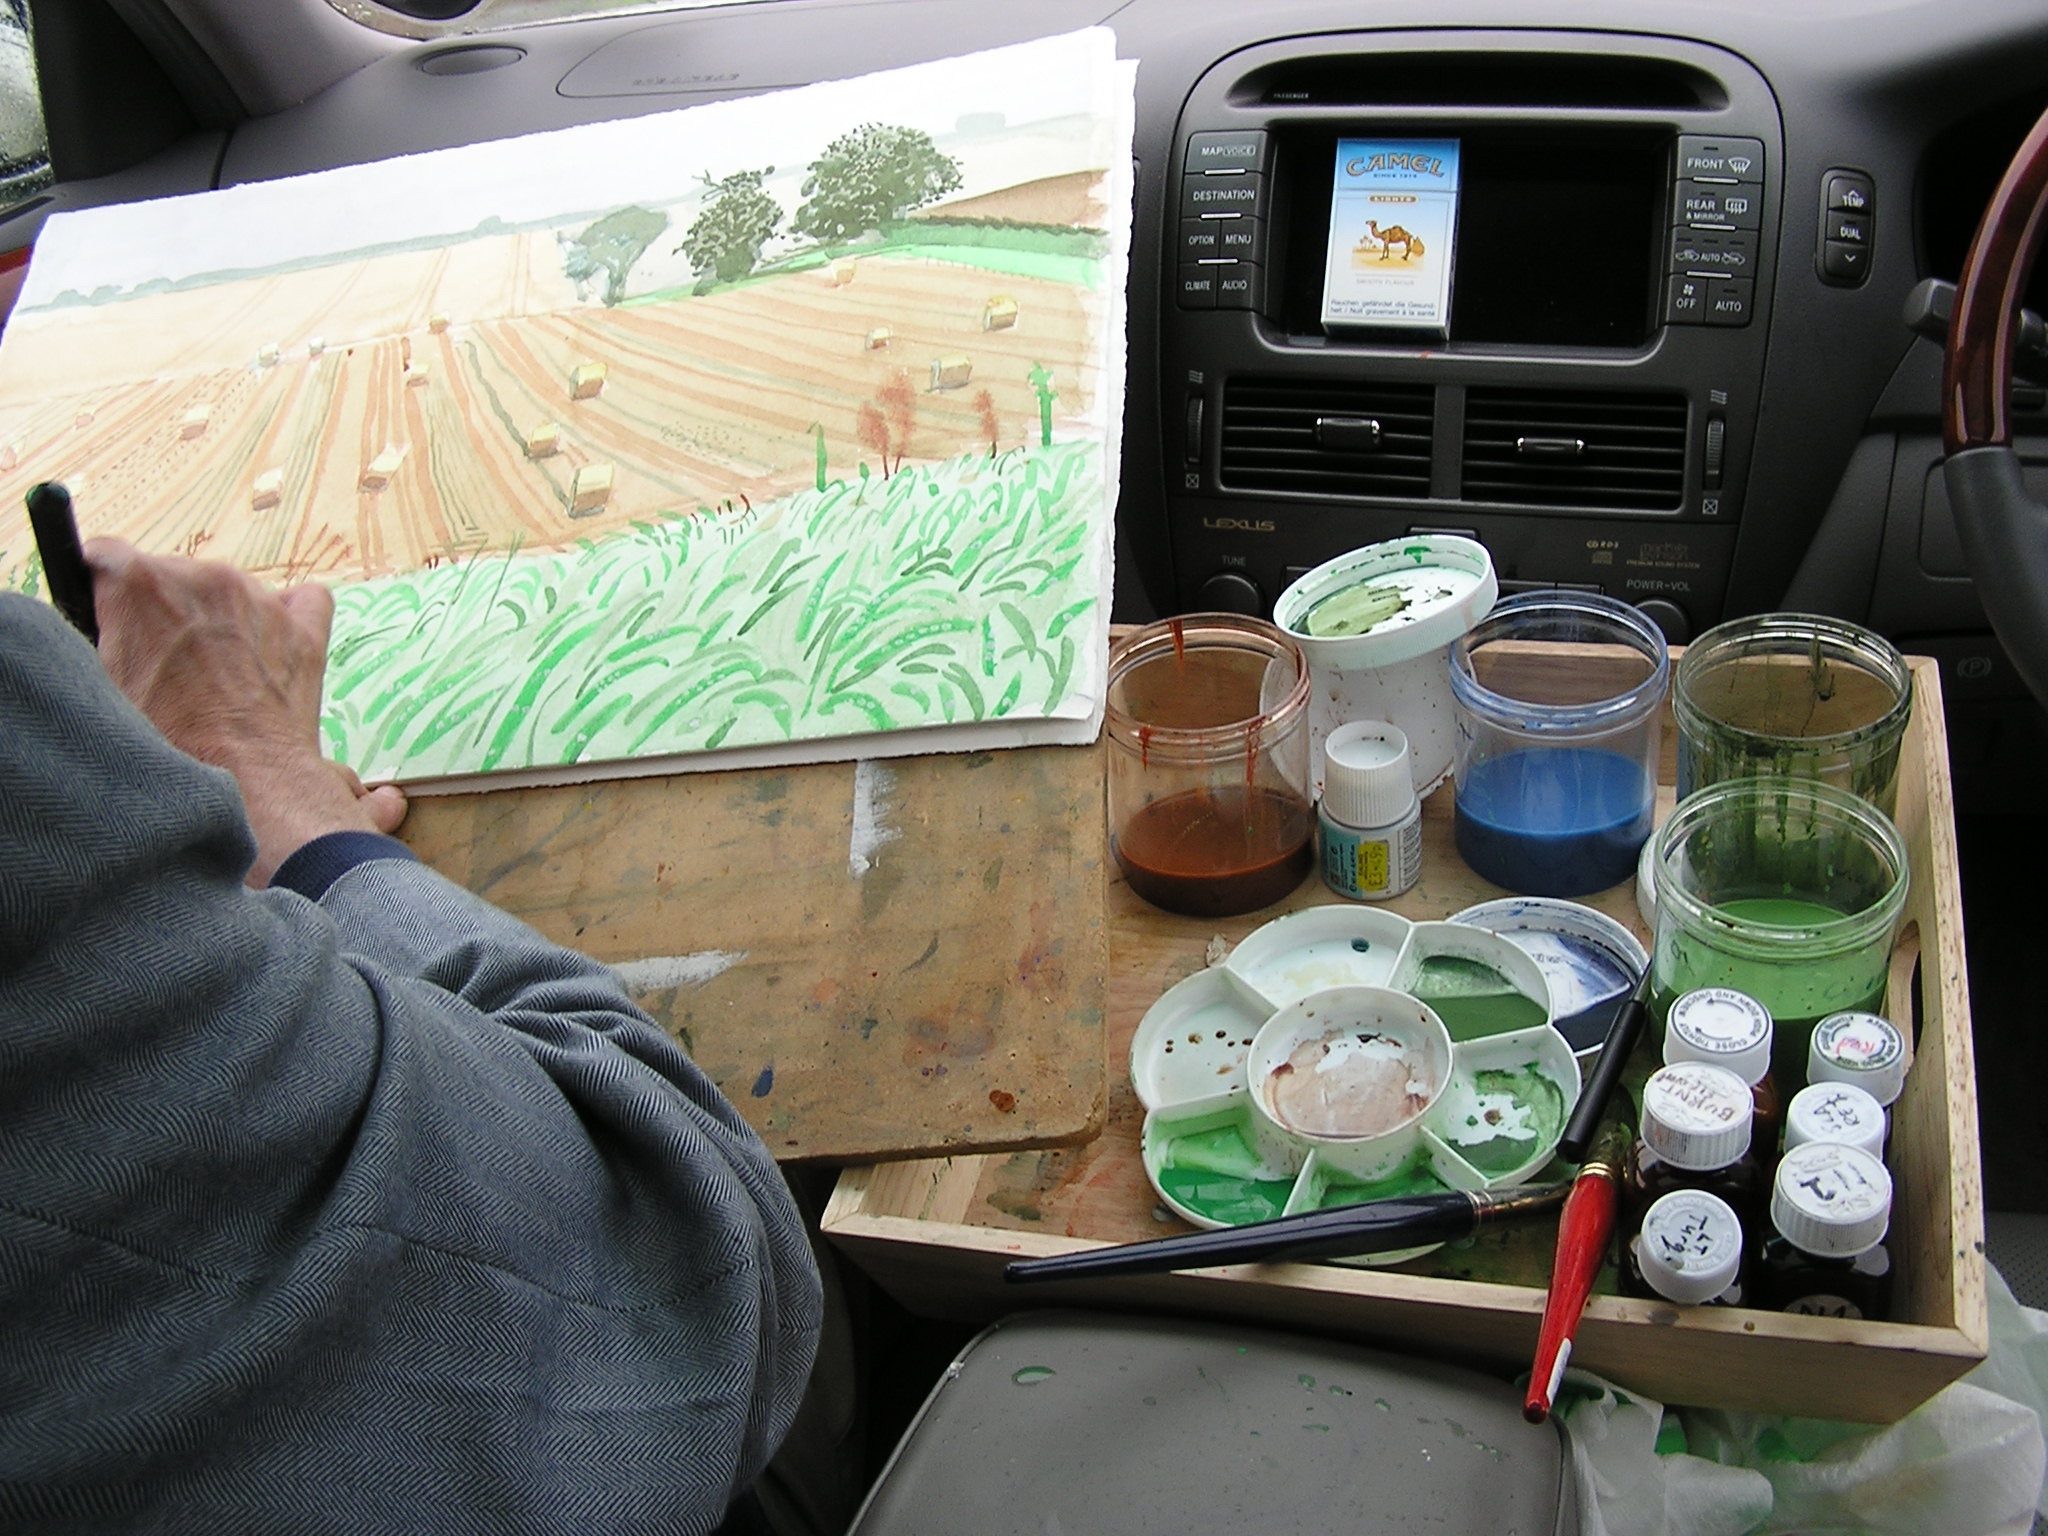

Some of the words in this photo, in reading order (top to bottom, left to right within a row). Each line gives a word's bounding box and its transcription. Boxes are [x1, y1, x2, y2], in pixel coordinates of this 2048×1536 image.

[1345, 152, 1445, 178] CAMEL
[1687, 157, 1724, 170] FRONT
[1193, 189, 1255, 201] DESTINATION
[1686, 198, 1716, 211] REAR
[1693, 213, 1725, 221] MIRROR
[1840, 226, 1861, 240] DUAL
[1188, 235, 1215, 245] OPTION
[1225, 234, 1252, 244] MENU
[1700, 252, 1720, 262] AUTO
[1185, 280, 1210, 291] CLIMATE
[1222, 280, 1247, 290] AUDIO
[1676, 299, 1697, 309] OFF
[1715, 301, 1742, 312] AUTO
[1203, 517, 1276, 532] LEXUS
[1222, 555, 1246, 566] TUNE
[1715, 991, 1736, 999] AND
[1714, 1038, 1748, 1050] CLOSE
